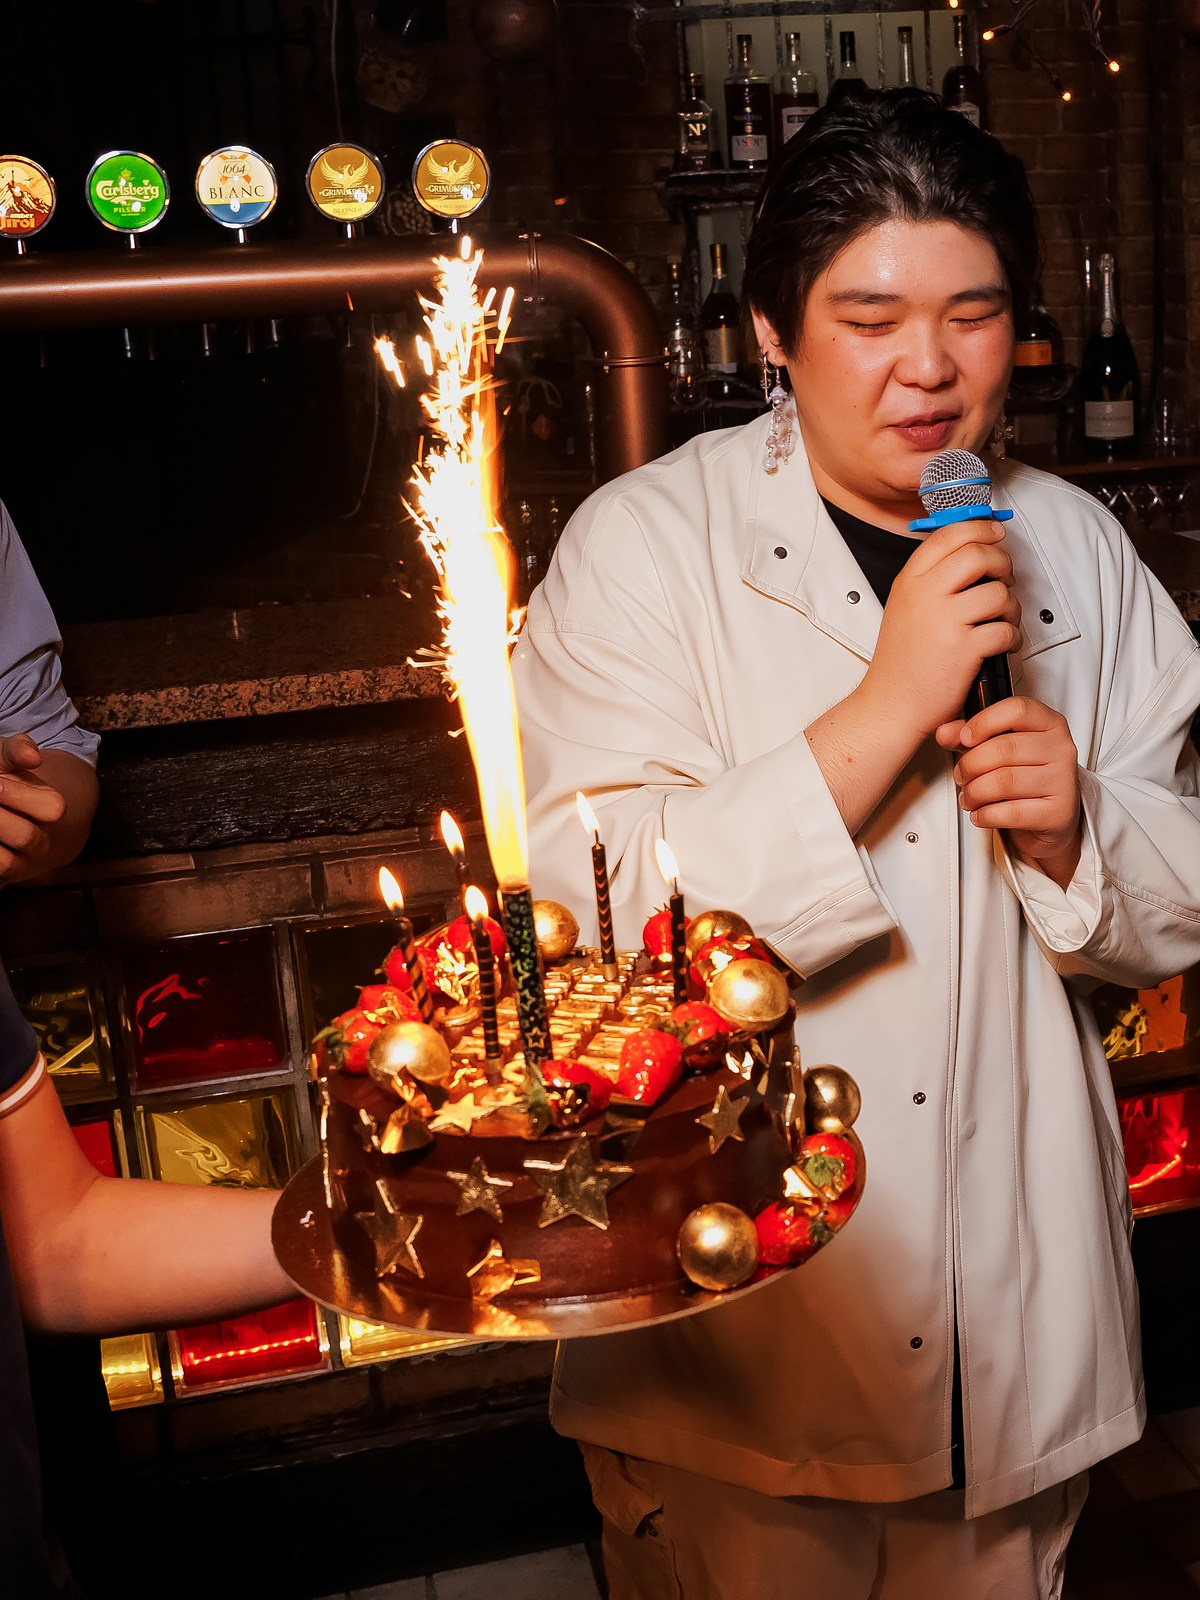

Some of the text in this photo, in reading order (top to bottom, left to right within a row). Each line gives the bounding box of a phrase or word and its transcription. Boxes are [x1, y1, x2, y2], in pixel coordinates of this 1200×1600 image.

[222, 163, 246, 174] 1664
[96, 179, 159, 201] Carlsberg
[209, 185, 265, 199] BLANC
